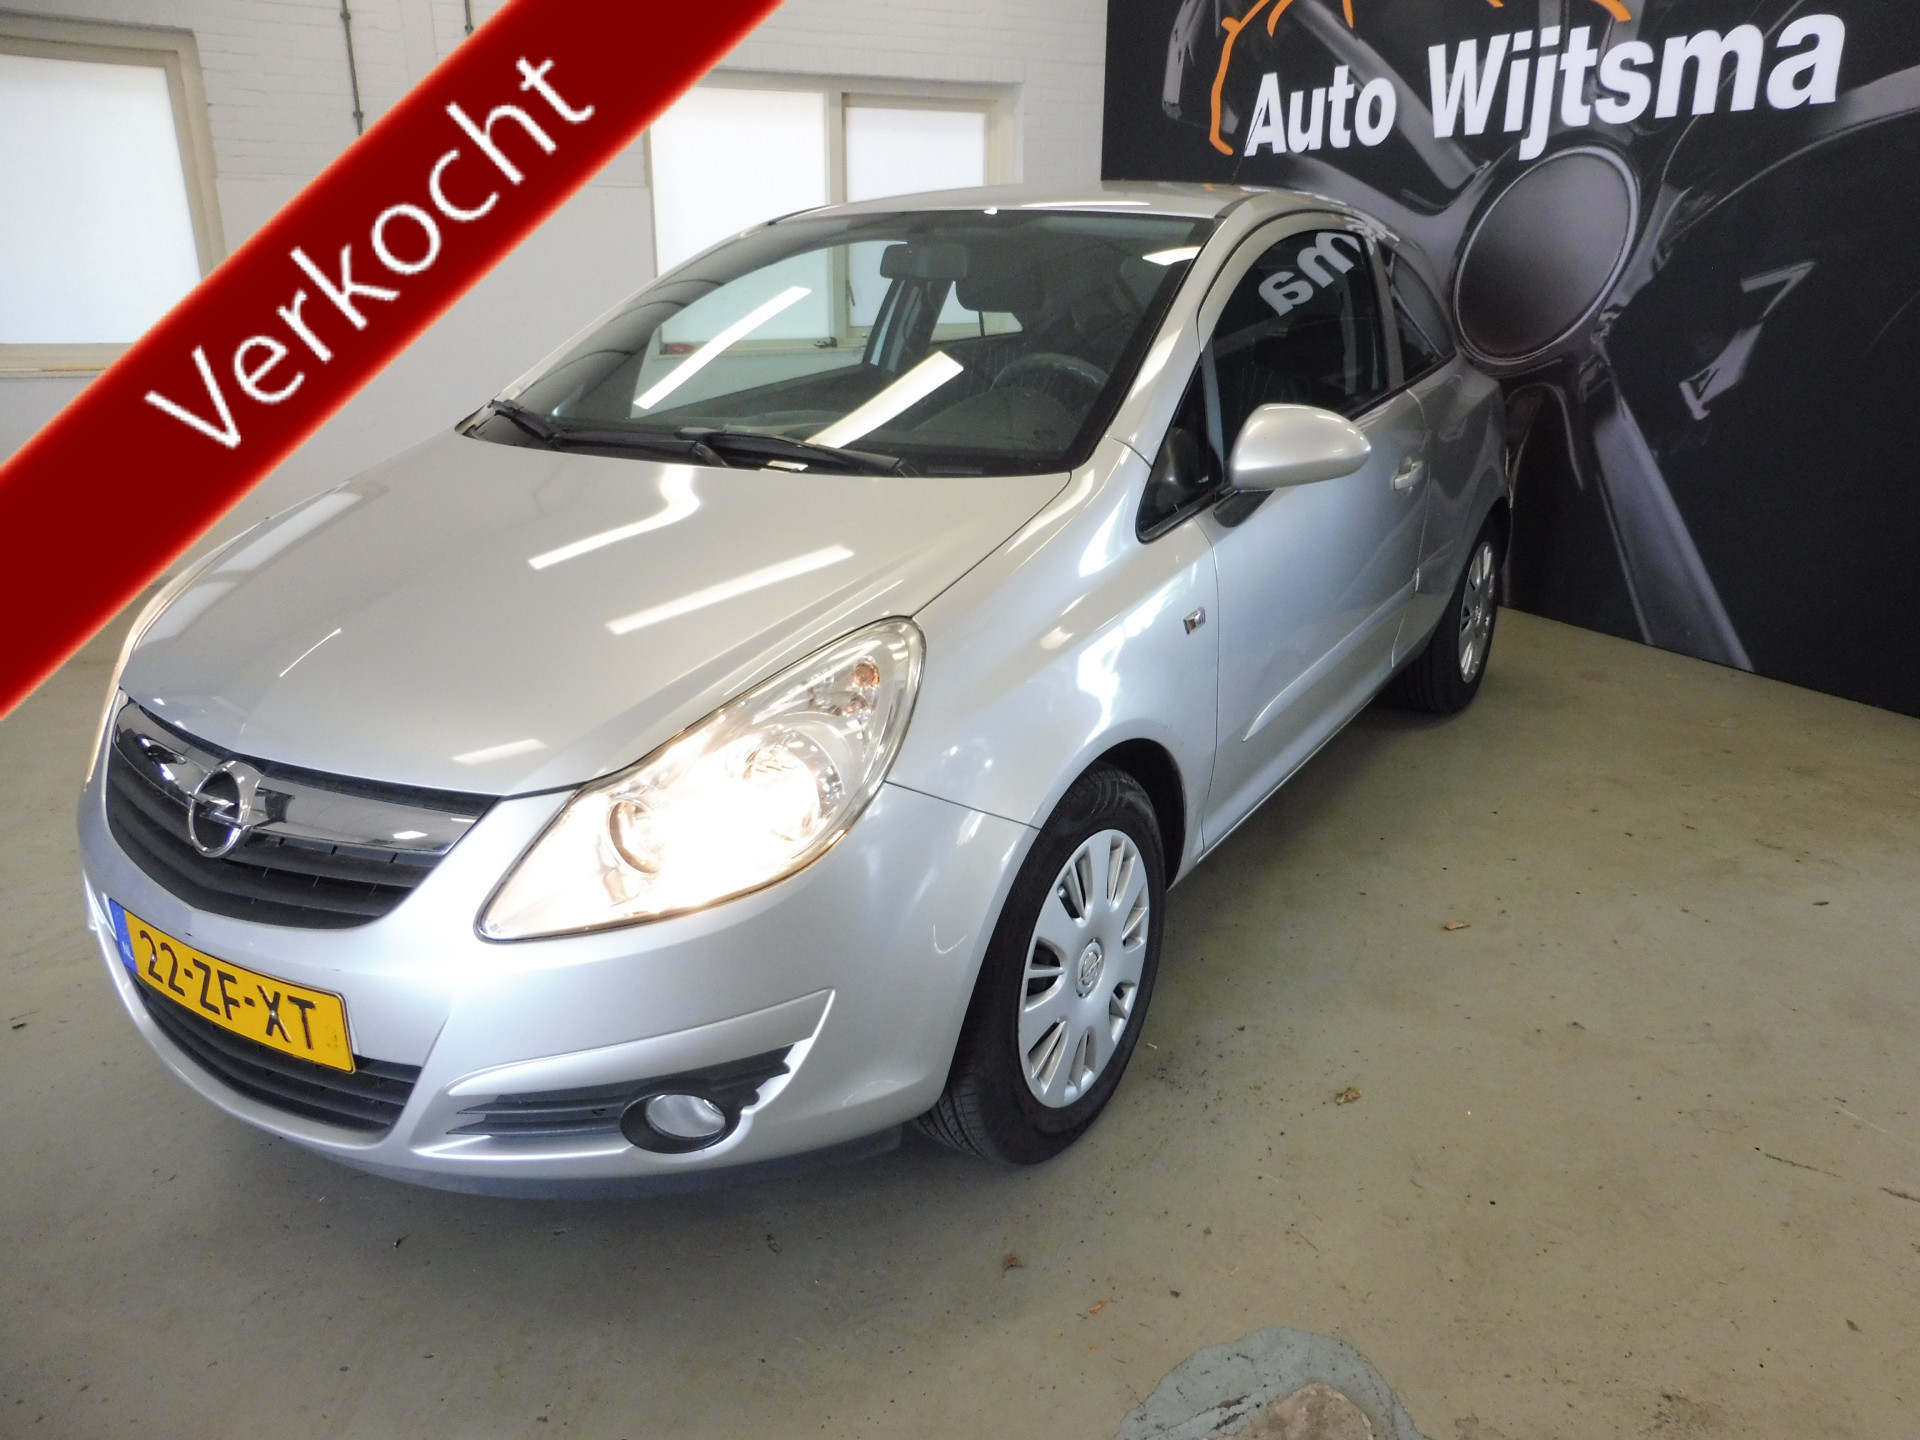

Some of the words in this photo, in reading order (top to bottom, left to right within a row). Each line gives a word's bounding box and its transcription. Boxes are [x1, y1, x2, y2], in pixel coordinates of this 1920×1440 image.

[1245, 65, 1397, 157] Auto
[1428, 14, 1845, 160] Wijtsma
[139, 929, 317, 1051] 22-ZF-XT
